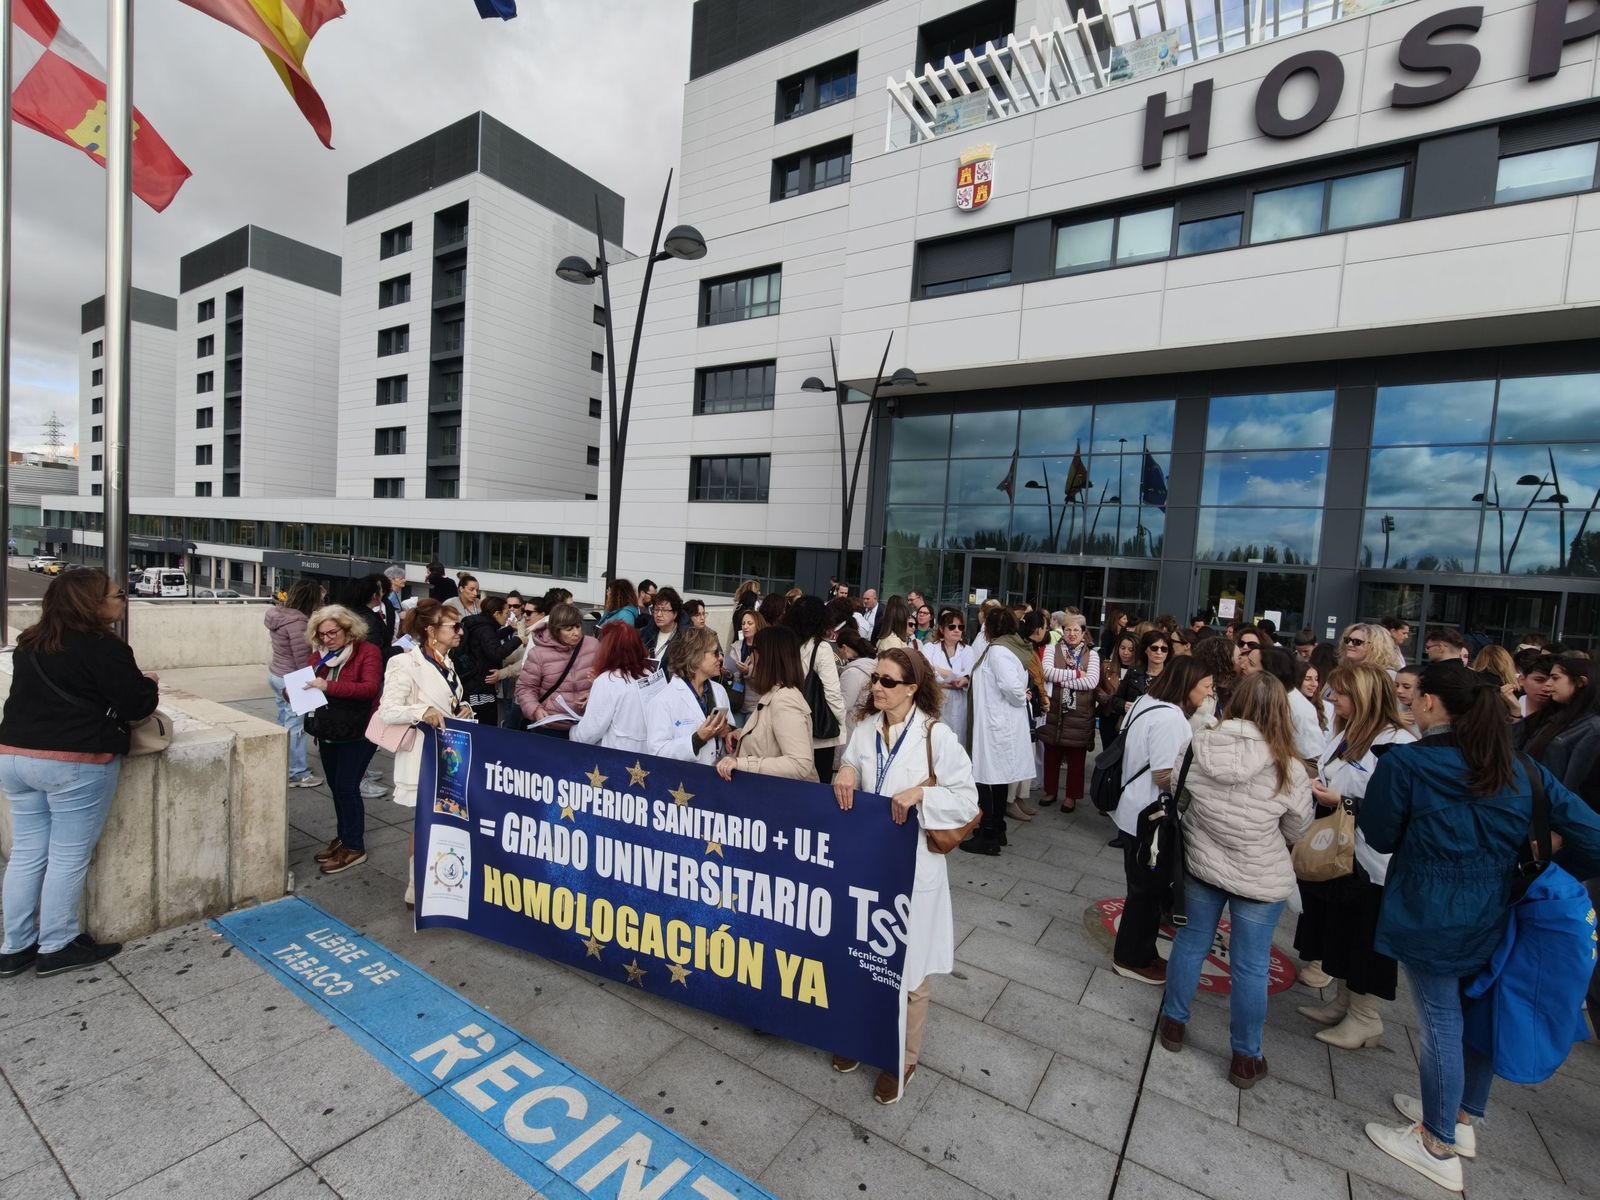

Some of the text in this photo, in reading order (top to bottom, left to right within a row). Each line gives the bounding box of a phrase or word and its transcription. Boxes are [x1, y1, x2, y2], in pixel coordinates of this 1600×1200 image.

[484, 760, 835, 869] TÉCNICO SUPERIOR SANITARIO + U.E.
[479, 812, 833, 937] = GRADO UNIVERSITARIO
[272, 943, 354, 996] TABACO
[305, 928, 400, 985] LIBRE DE
[483, 864, 829, 1009] HOMOLOGACIÓN YA
[848, 946, 888, 966] Técnicos
[411, 1023, 740, 1200] RECIN
